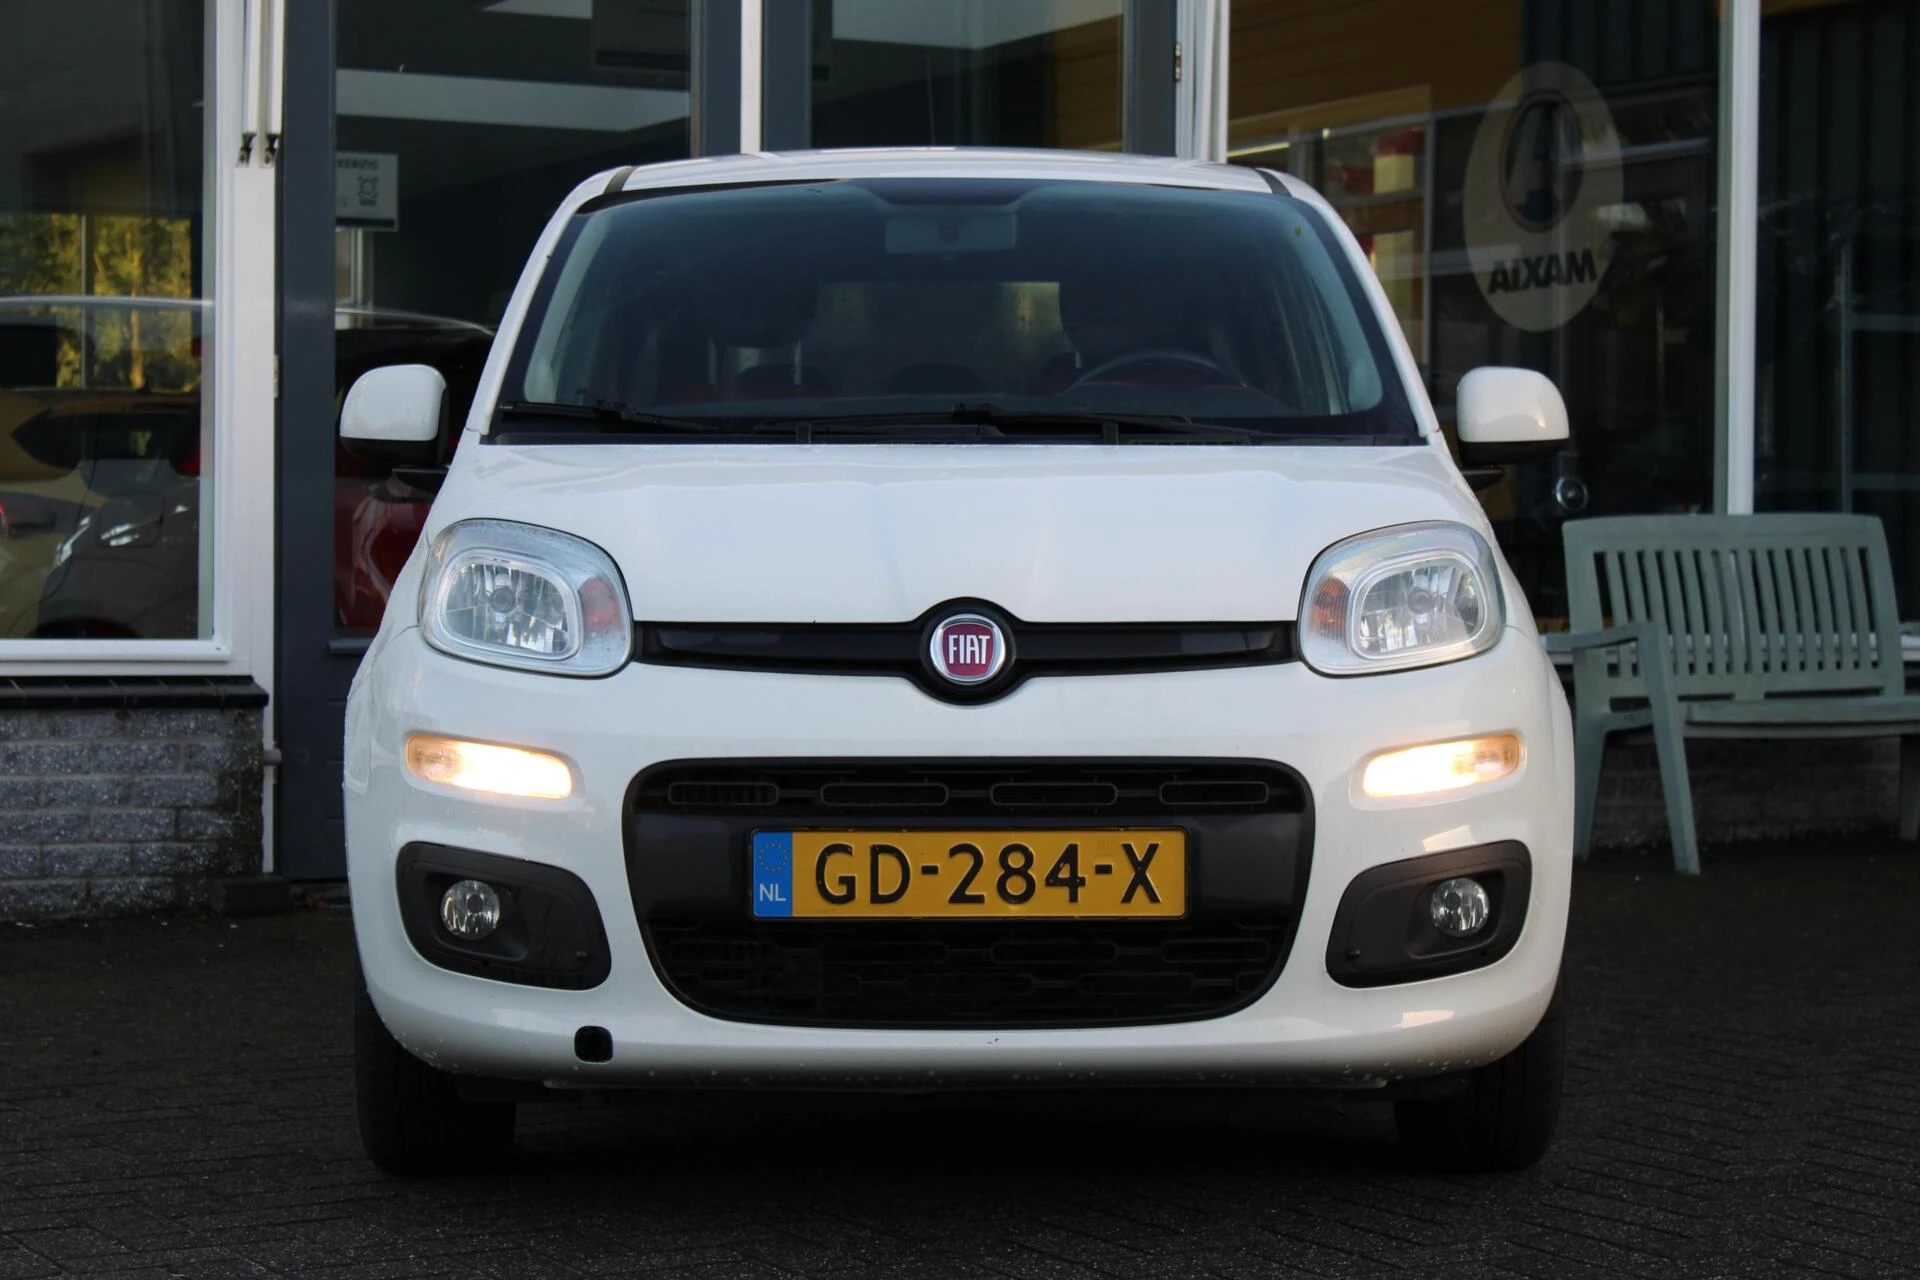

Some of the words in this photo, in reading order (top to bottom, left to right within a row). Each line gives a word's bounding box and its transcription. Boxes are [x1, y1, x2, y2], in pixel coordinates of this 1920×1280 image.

[948, 634, 990, 665] FIAT
[814, 842, 1163, 905] GD-284-X
[759, 884, 787, 902] NL
